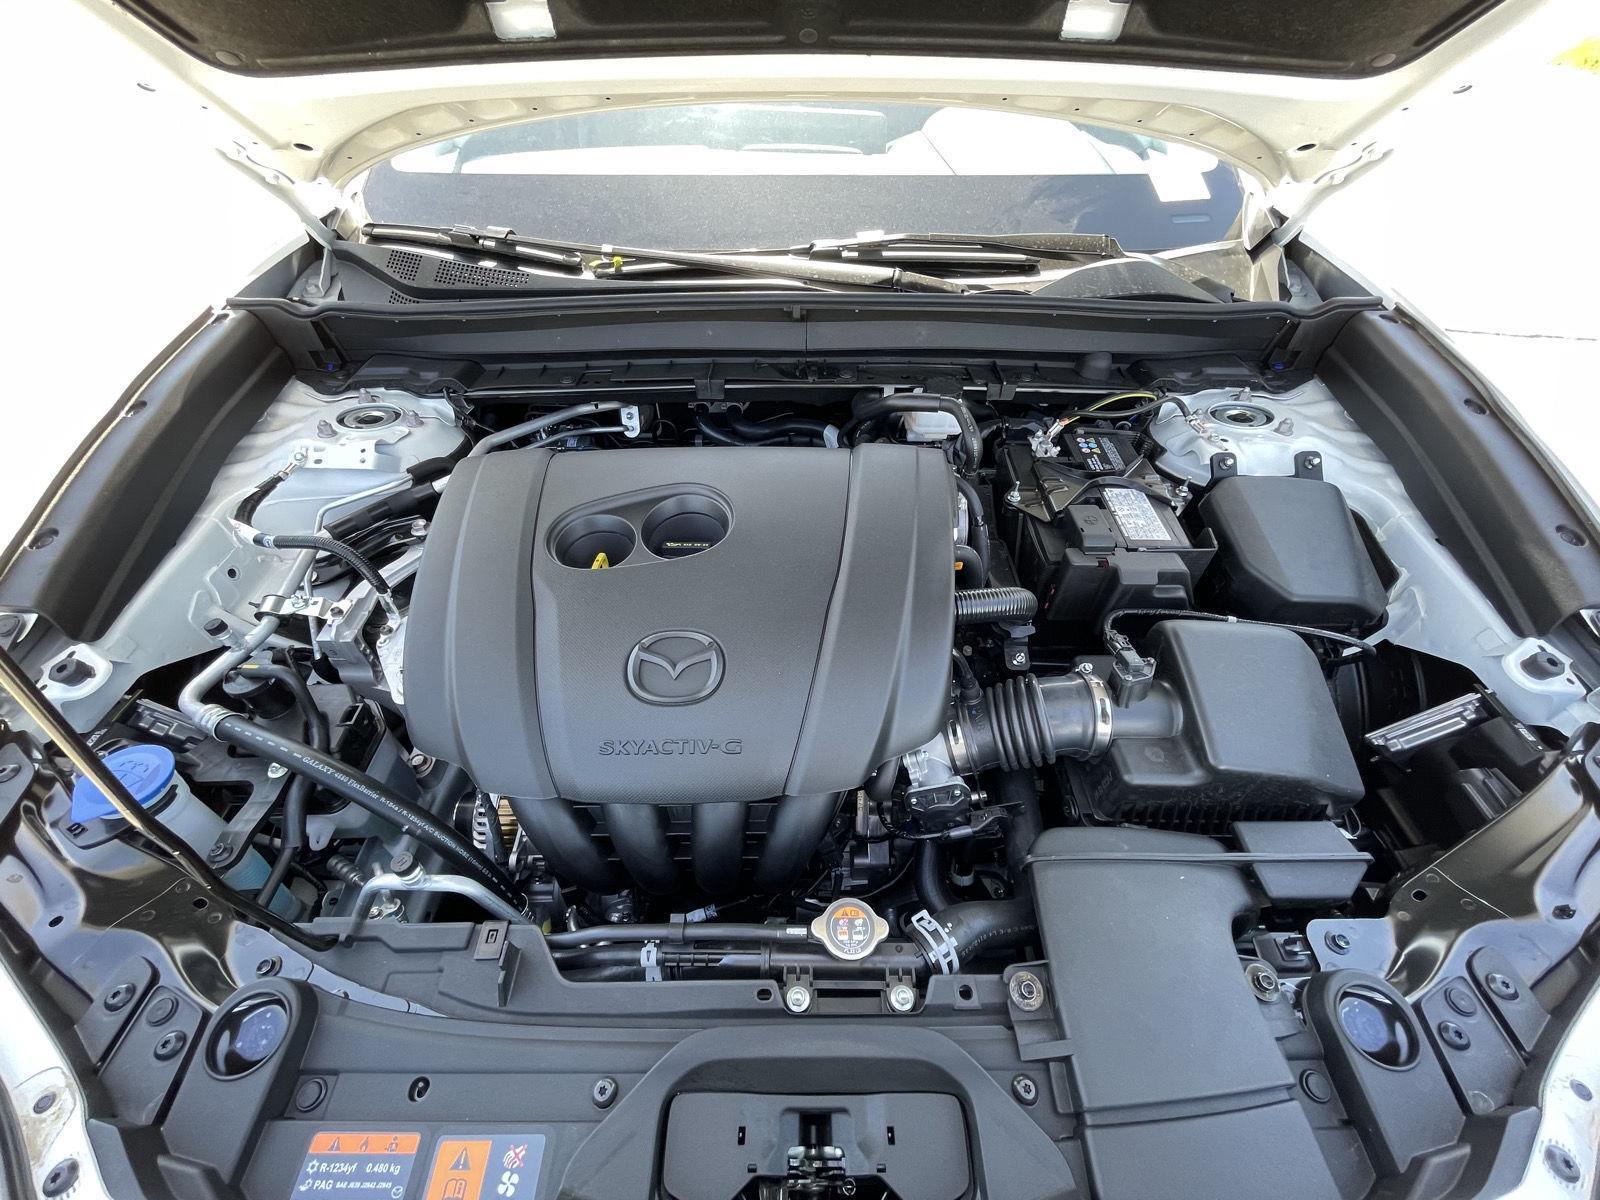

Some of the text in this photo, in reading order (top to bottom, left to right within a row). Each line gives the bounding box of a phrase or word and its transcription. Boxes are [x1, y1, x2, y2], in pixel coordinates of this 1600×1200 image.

[599, 738, 743, 755] SKYACTIV-G
[302, 756, 335, 775] GALAXY
[319, 1162, 401, 1175] R-1234yf 0.480 kg
[313, 1180, 334, 1190] PAG
